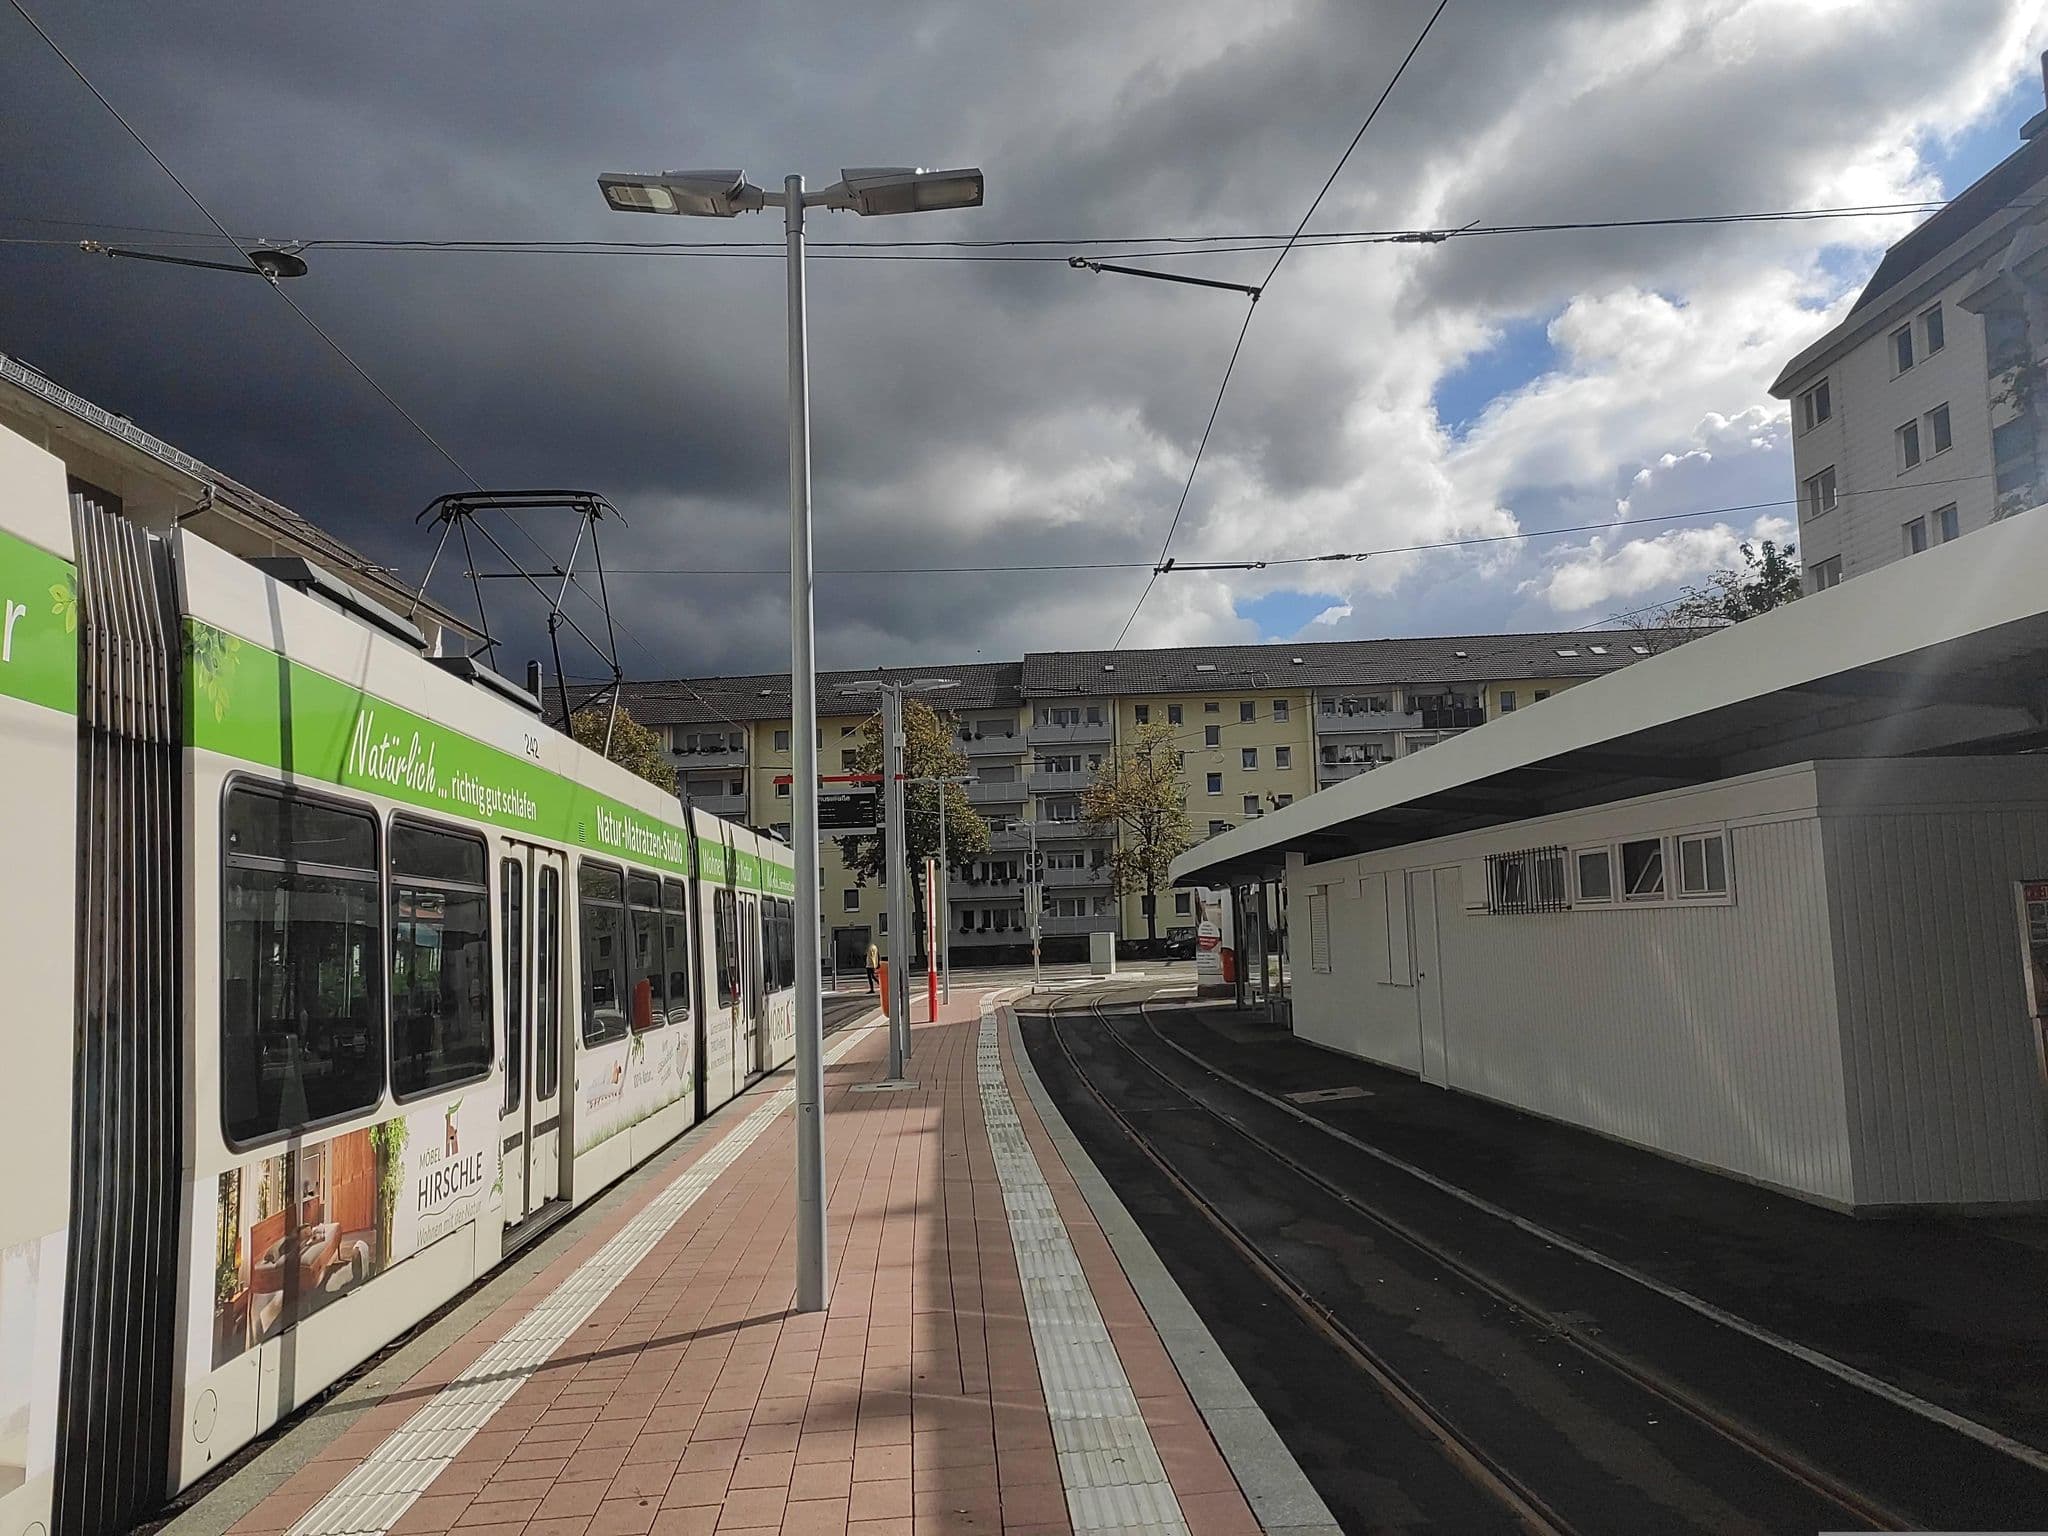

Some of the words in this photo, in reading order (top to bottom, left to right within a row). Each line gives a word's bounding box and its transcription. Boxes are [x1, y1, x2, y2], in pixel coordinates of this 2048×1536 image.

[348, 709, 437, 794] Natürlich
[451, 771, 486, 815] richtig
[486, 786, 502, 817] gut
[502, 788, 537, 821] schlafen
[524, 733, 540, 759] 242
[596, 805, 683, 865] Natur-Matratzen-Studio
[418, 1151, 483, 1212] HIRSCHLE
[419, 1147, 441, 1170] MÖBEL
